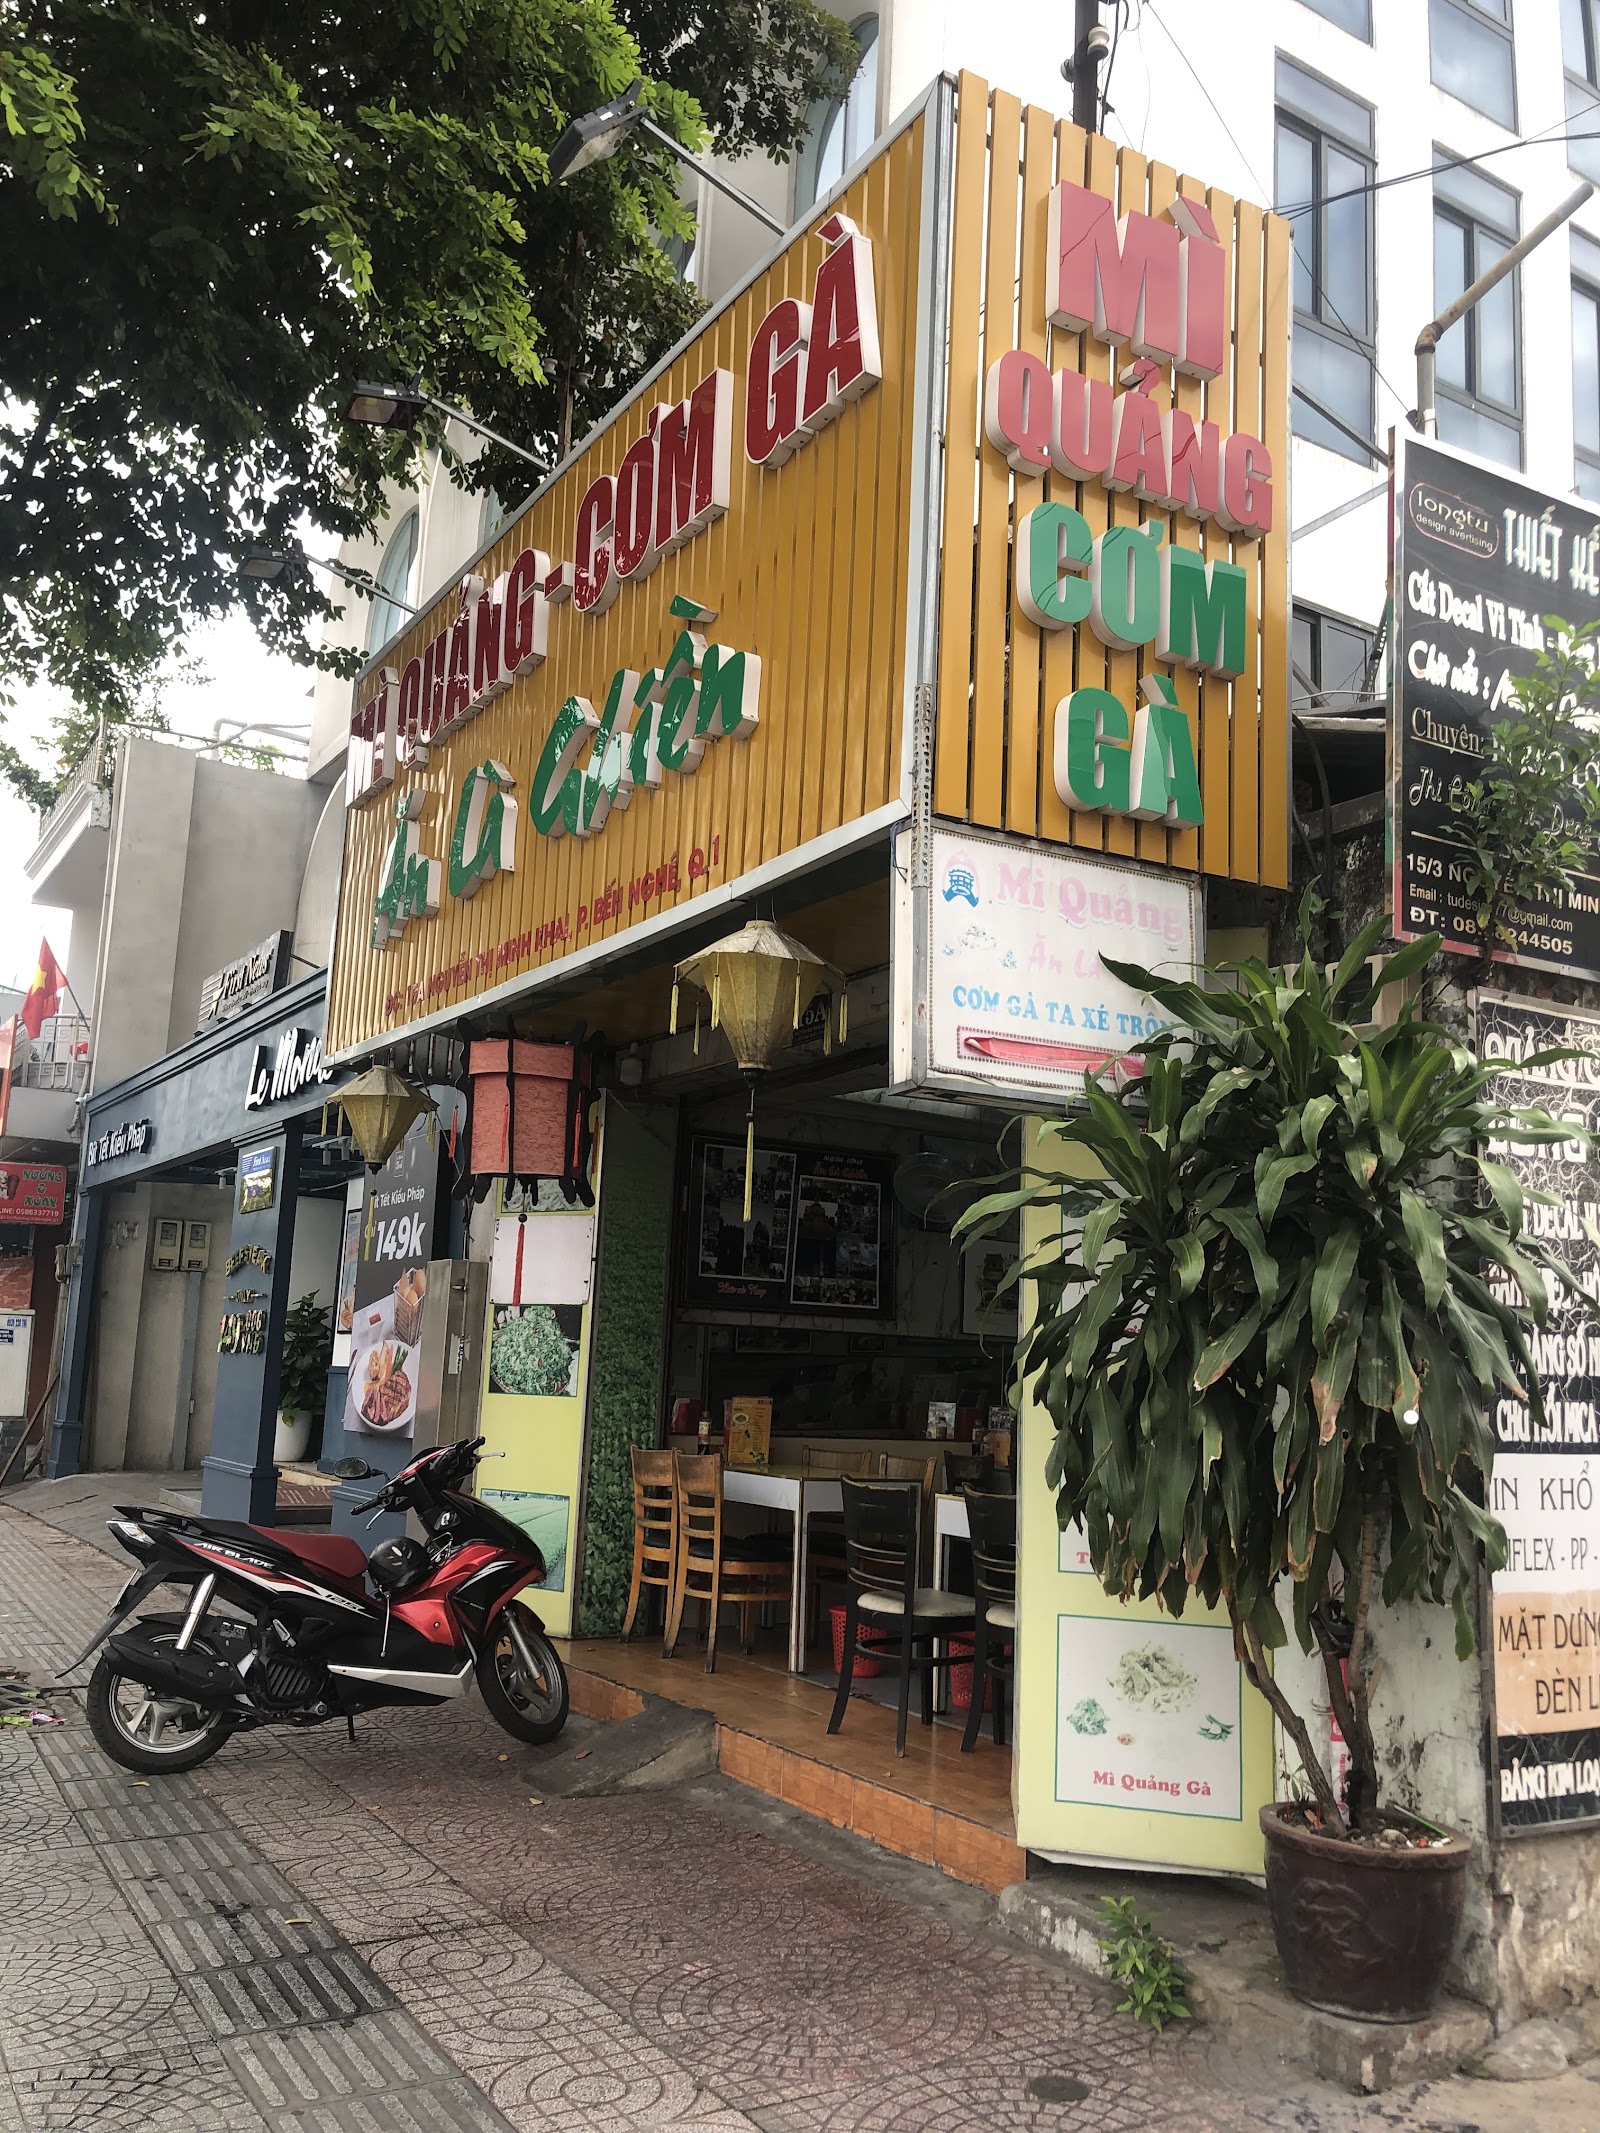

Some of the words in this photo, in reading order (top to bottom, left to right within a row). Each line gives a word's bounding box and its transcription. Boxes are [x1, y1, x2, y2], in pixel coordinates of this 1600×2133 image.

[1045, 180, 1226, 383] MÌ
[985, 350, 1273, 540] QUẢNG
[346, 666, 400, 809] MÌ
[396, 547, 551, 772] QUẢNG
[573, 366, 735, 617] CƠM
[745, 212, 882, 470] GÀ
[1416, 513, 1448, 533] design
[1448, 526, 1494, 553] avertising
[1503, 504, 1563, 583] THIẾT
[1016, 501, 1247, 681] CƠM
[1438, 581, 1485, 634] Decal
[1054, 673, 1205, 831] GÀ
[1406, 853, 1443, 879] 15/3
[997, 861, 1048, 912] Mì
[1057, 874, 1186, 948] Quảng
[1409, 883, 1437, 902] Email
[407, 980, 425, 1007] 15A
[427, 950, 473, 999] NGUYỄN
[475, 946, 494, 979] THỊ
[496, 932, 532, 969] MINH
[576, 908, 589, 935] P.
[592, 877, 624, 926] BẾN
[627, 851, 683, 907] NGHÉ,
[953, 984, 1001, 1013] CƠM
[1006, 991, 1040, 1022] GÀ
[1045, 1001, 1076, 1027] TA
[1081, 1003, 1111, 1033] XÉ
[244, 1044, 270, 1111] Le
[407, 1184, 425, 1203] Pháp
[375, 1211, 427, 1263] 149k
[1564, 1401, 1599, 1443] MICA
[1493, 1476, 1519, 1510] IN
[1540, 1460, 1593, 1510] KHỔ
[194, 1541, 224, 1555] AIR
[224, 1549, 276, 1570] BLADE
[1504, 1538, 1556, 1572] IFLEX
[1570, 1537, 1588, 1570] PP
[1498, 1607, 1547, 1659] MẶT
[1535, 1667, 1582, 1715] ĐÈN
[1093, 1771, 1115, 1786] Mì
[1121, 1774, 1181, 1797] Quảng
[1186, 1780, 1212, 1797] Gà
[1500, 1757, 1547, 1803] BẢNG
